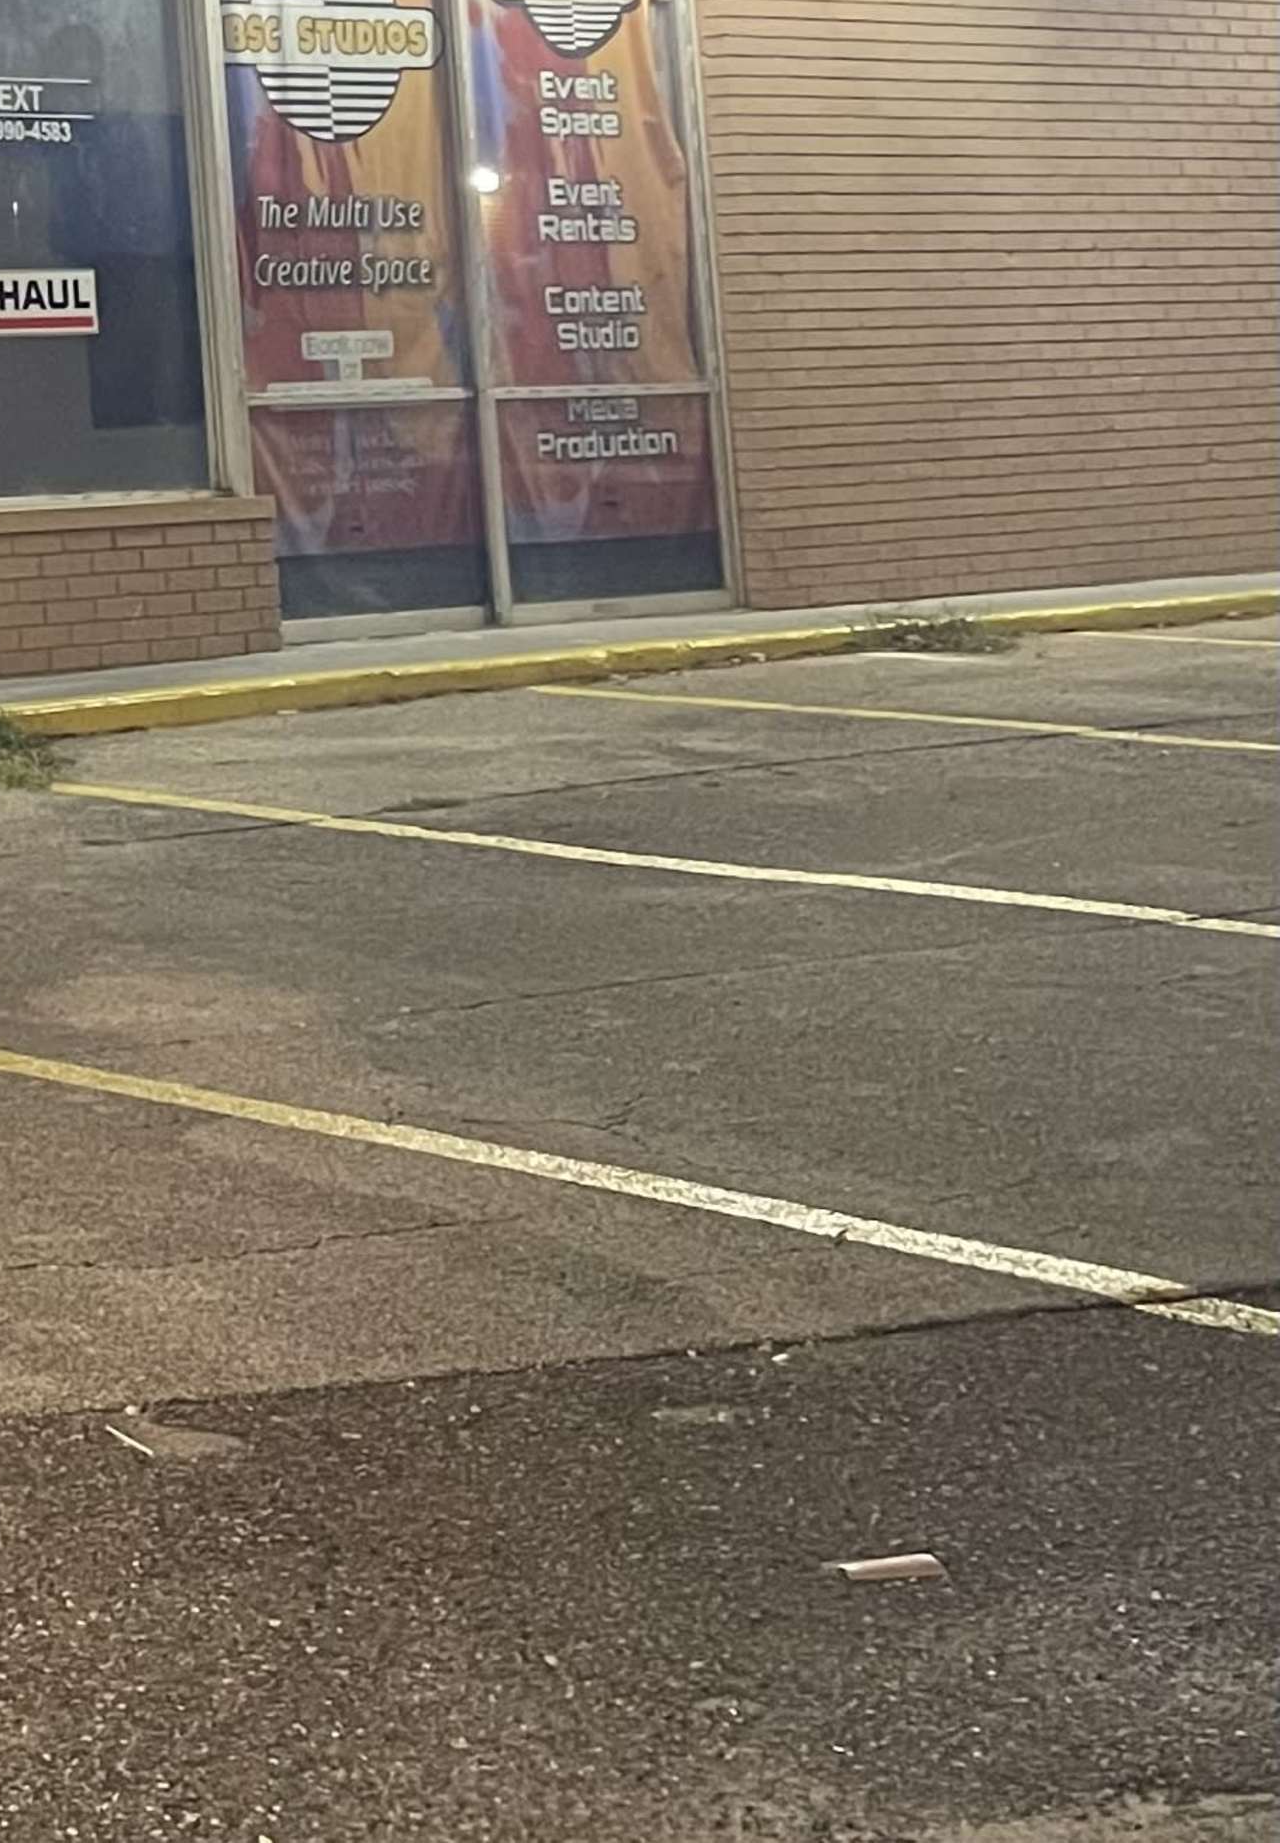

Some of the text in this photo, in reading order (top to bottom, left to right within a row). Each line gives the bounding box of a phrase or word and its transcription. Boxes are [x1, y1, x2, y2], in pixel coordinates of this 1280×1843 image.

[296, 15, 428, 56] STUDIOS
[540, 71, 616, 100] Event
[540, 107, 620, 141] Space
[548, 178, 622, 206] Event
[257, 195, 422, 228] The Multi Use
[538, 213, 637, 242] Rentals
[255, 254, 432, 293] Creative Space
[545, 285, 646, 314] Content
[557, 320, 640, 350] Studio
[537, 427, 679, 460] Production
